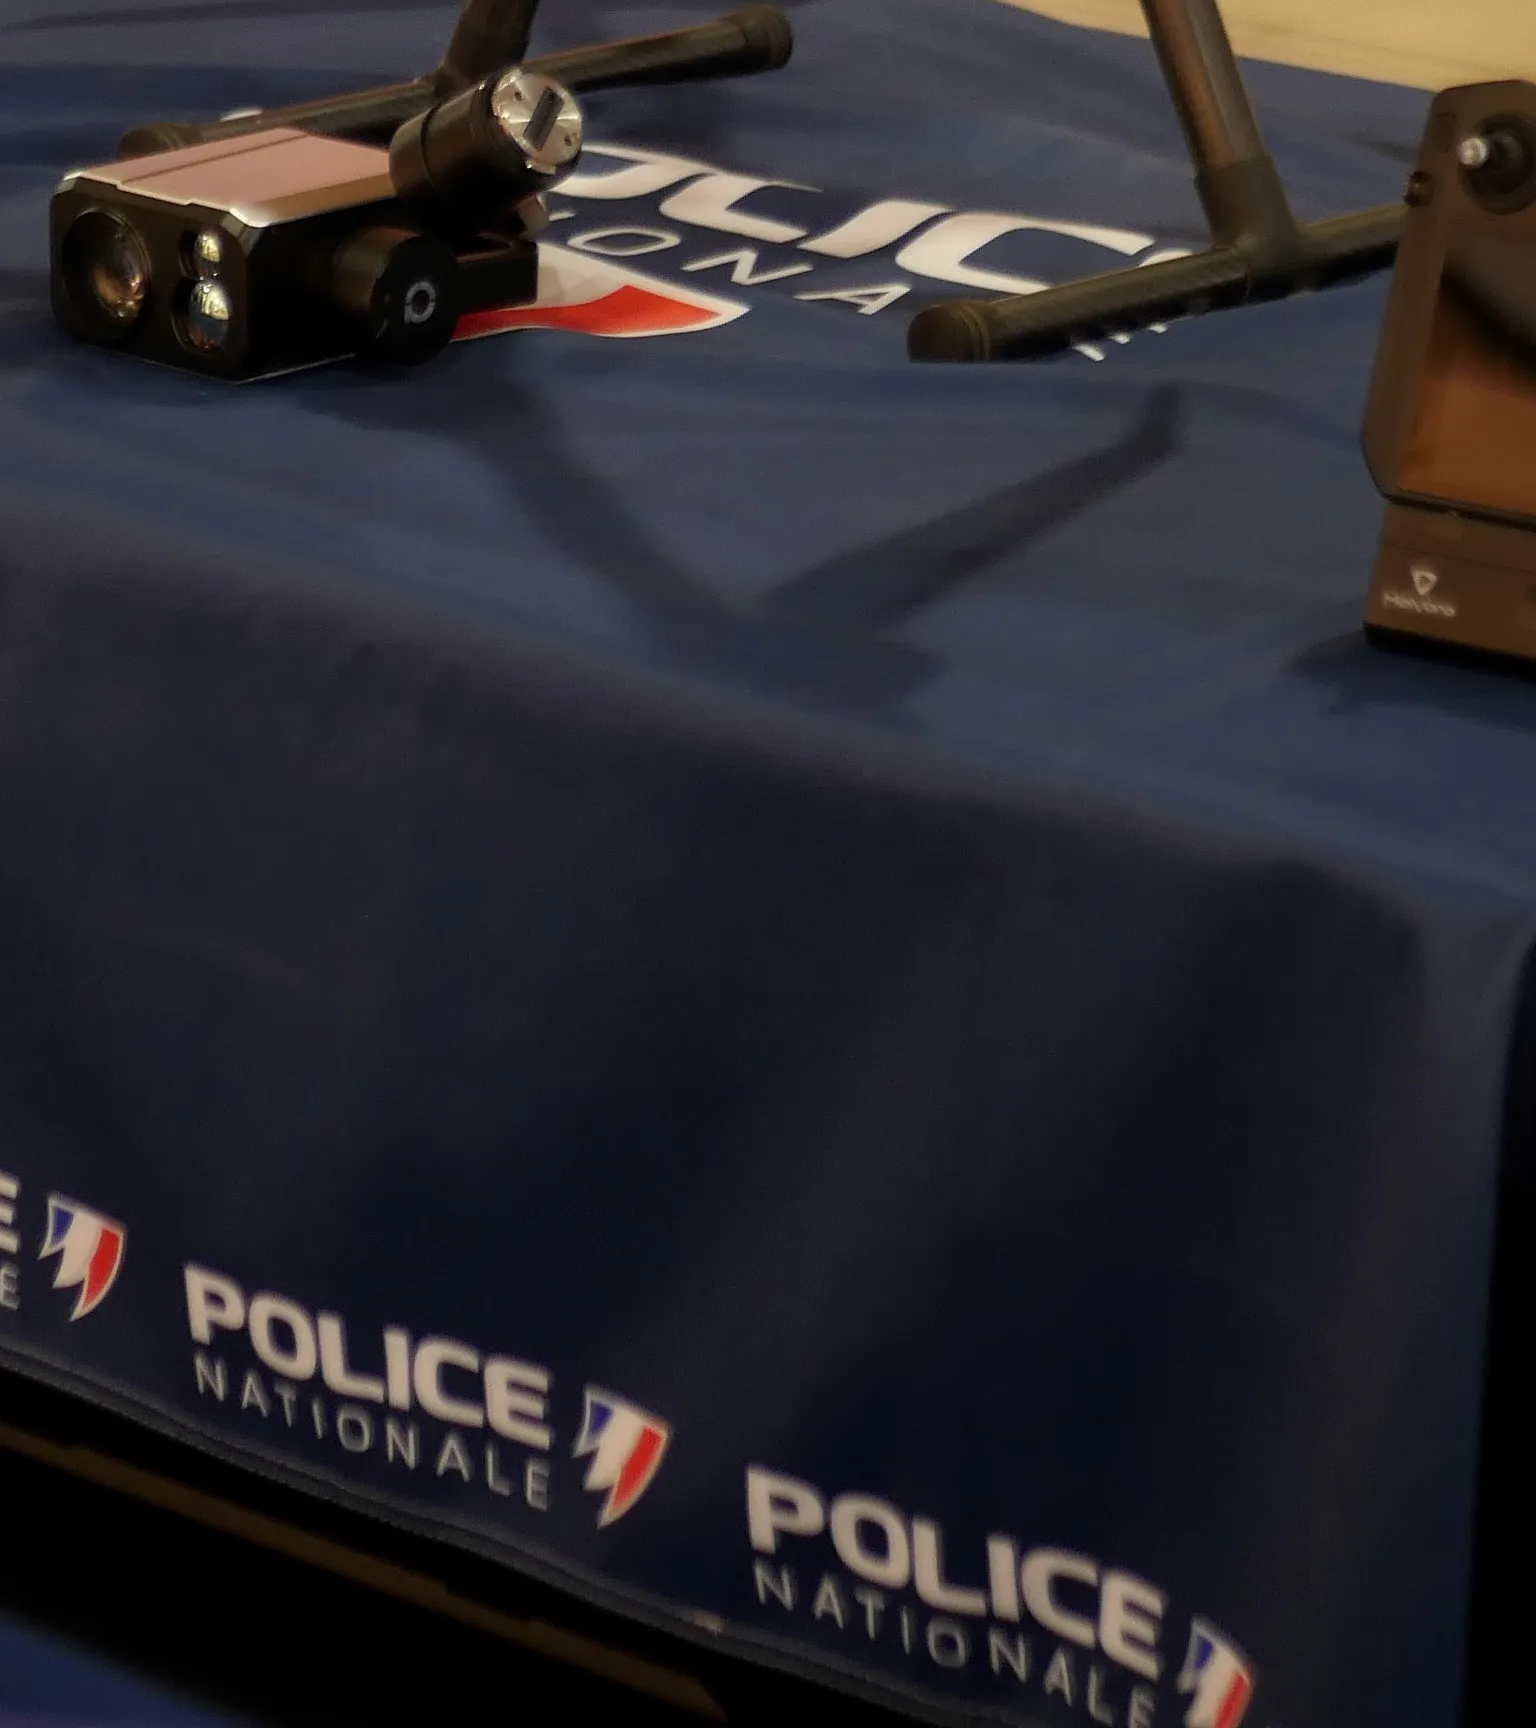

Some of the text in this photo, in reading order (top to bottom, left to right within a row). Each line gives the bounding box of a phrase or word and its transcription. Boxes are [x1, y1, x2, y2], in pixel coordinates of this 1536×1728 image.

[183, 1260, 554, 1452] POLICE
[192, 1348, 551, 1512] NATIONALE
[745, 1464, 1169, 1683] POLICE
[751, 1558, 1159, 1728] NATIONALE
